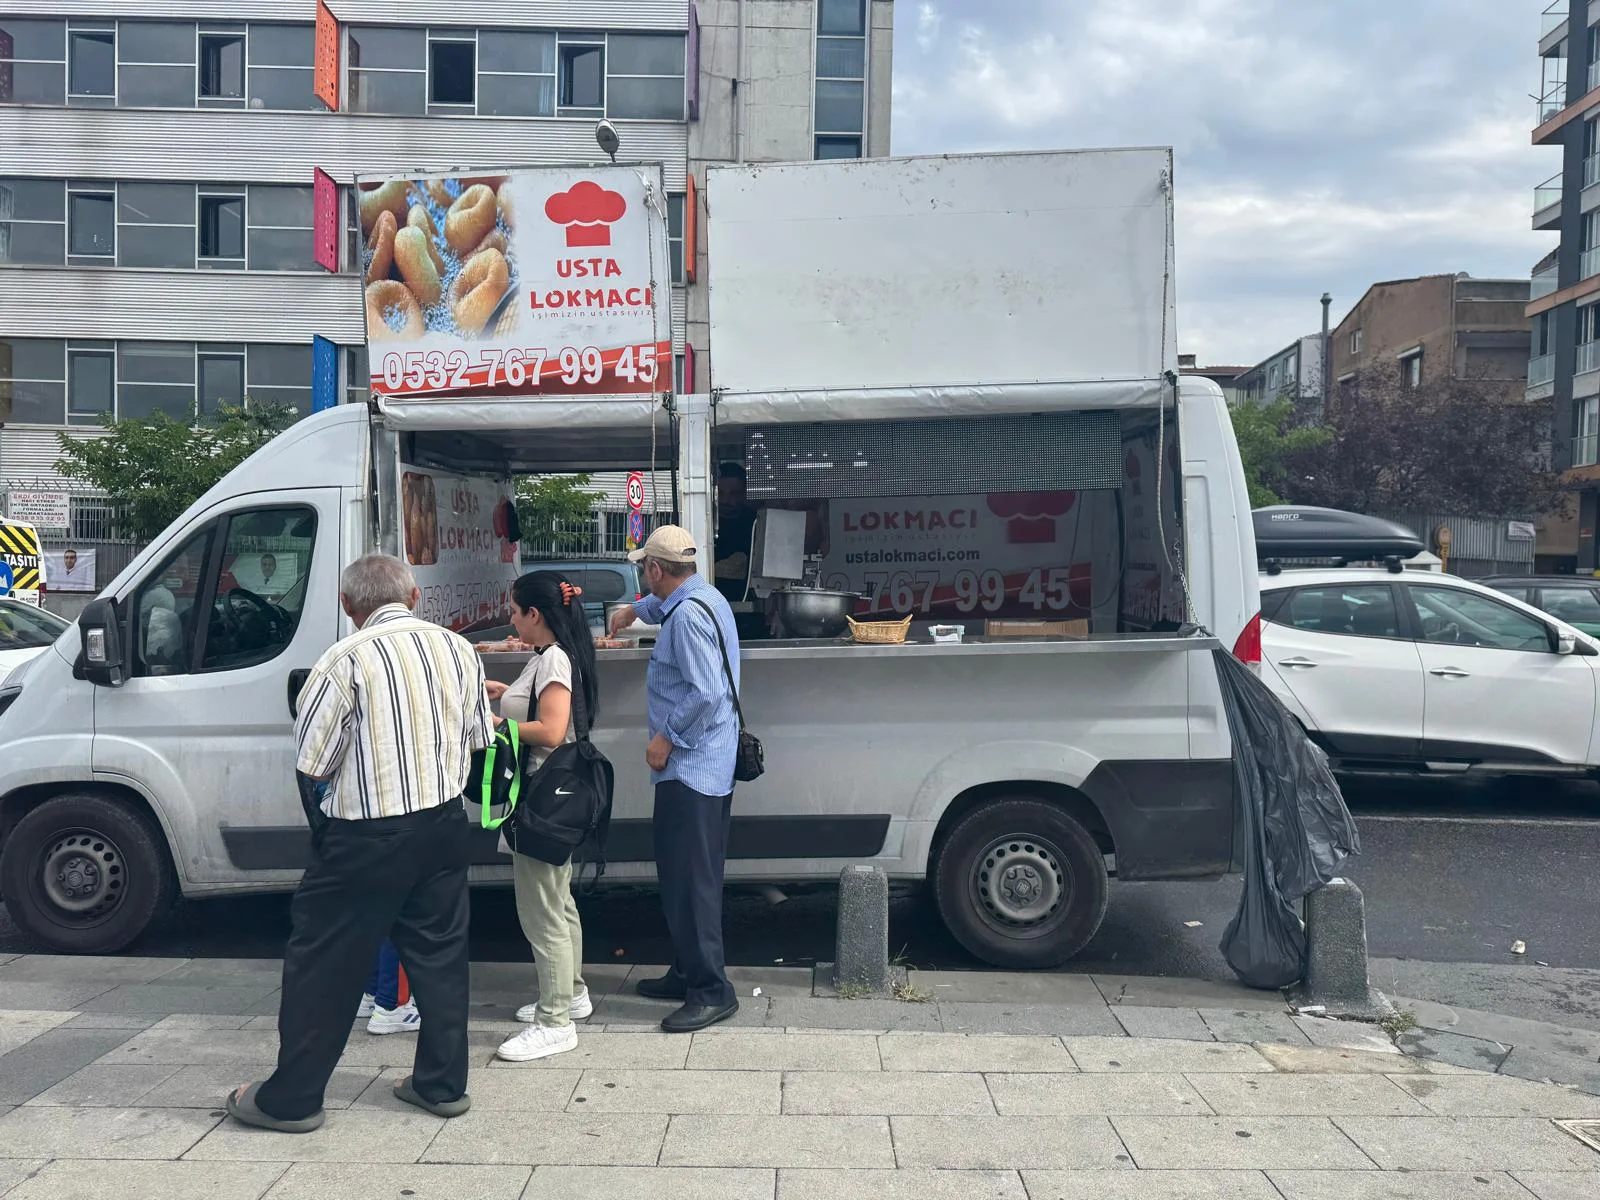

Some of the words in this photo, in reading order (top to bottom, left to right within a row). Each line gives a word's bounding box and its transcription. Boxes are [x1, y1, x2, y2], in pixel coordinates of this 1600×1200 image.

[556, 258, 622, 278] USTA
[530, 287, 652, 309] LOKMACI
[383, 350, 470, 390] 0532
[481, 347, 547, 387] 767
[559, 346, 603, 385] 99
[615, 345, 658, 383] 45
[452, 488, 479, 514] USTA
[630, 485, 641, 499] 30
[843, 509, 978, 532] LOKMACI
[439, 525, 495, 552] LOKMACI
[845, 548, 981, 564] ustalokmaci.com
[863, 571, 941, 613] 767
[953, 569, 1005, 612] 99
[1018, 567, 1071, 611] 45
